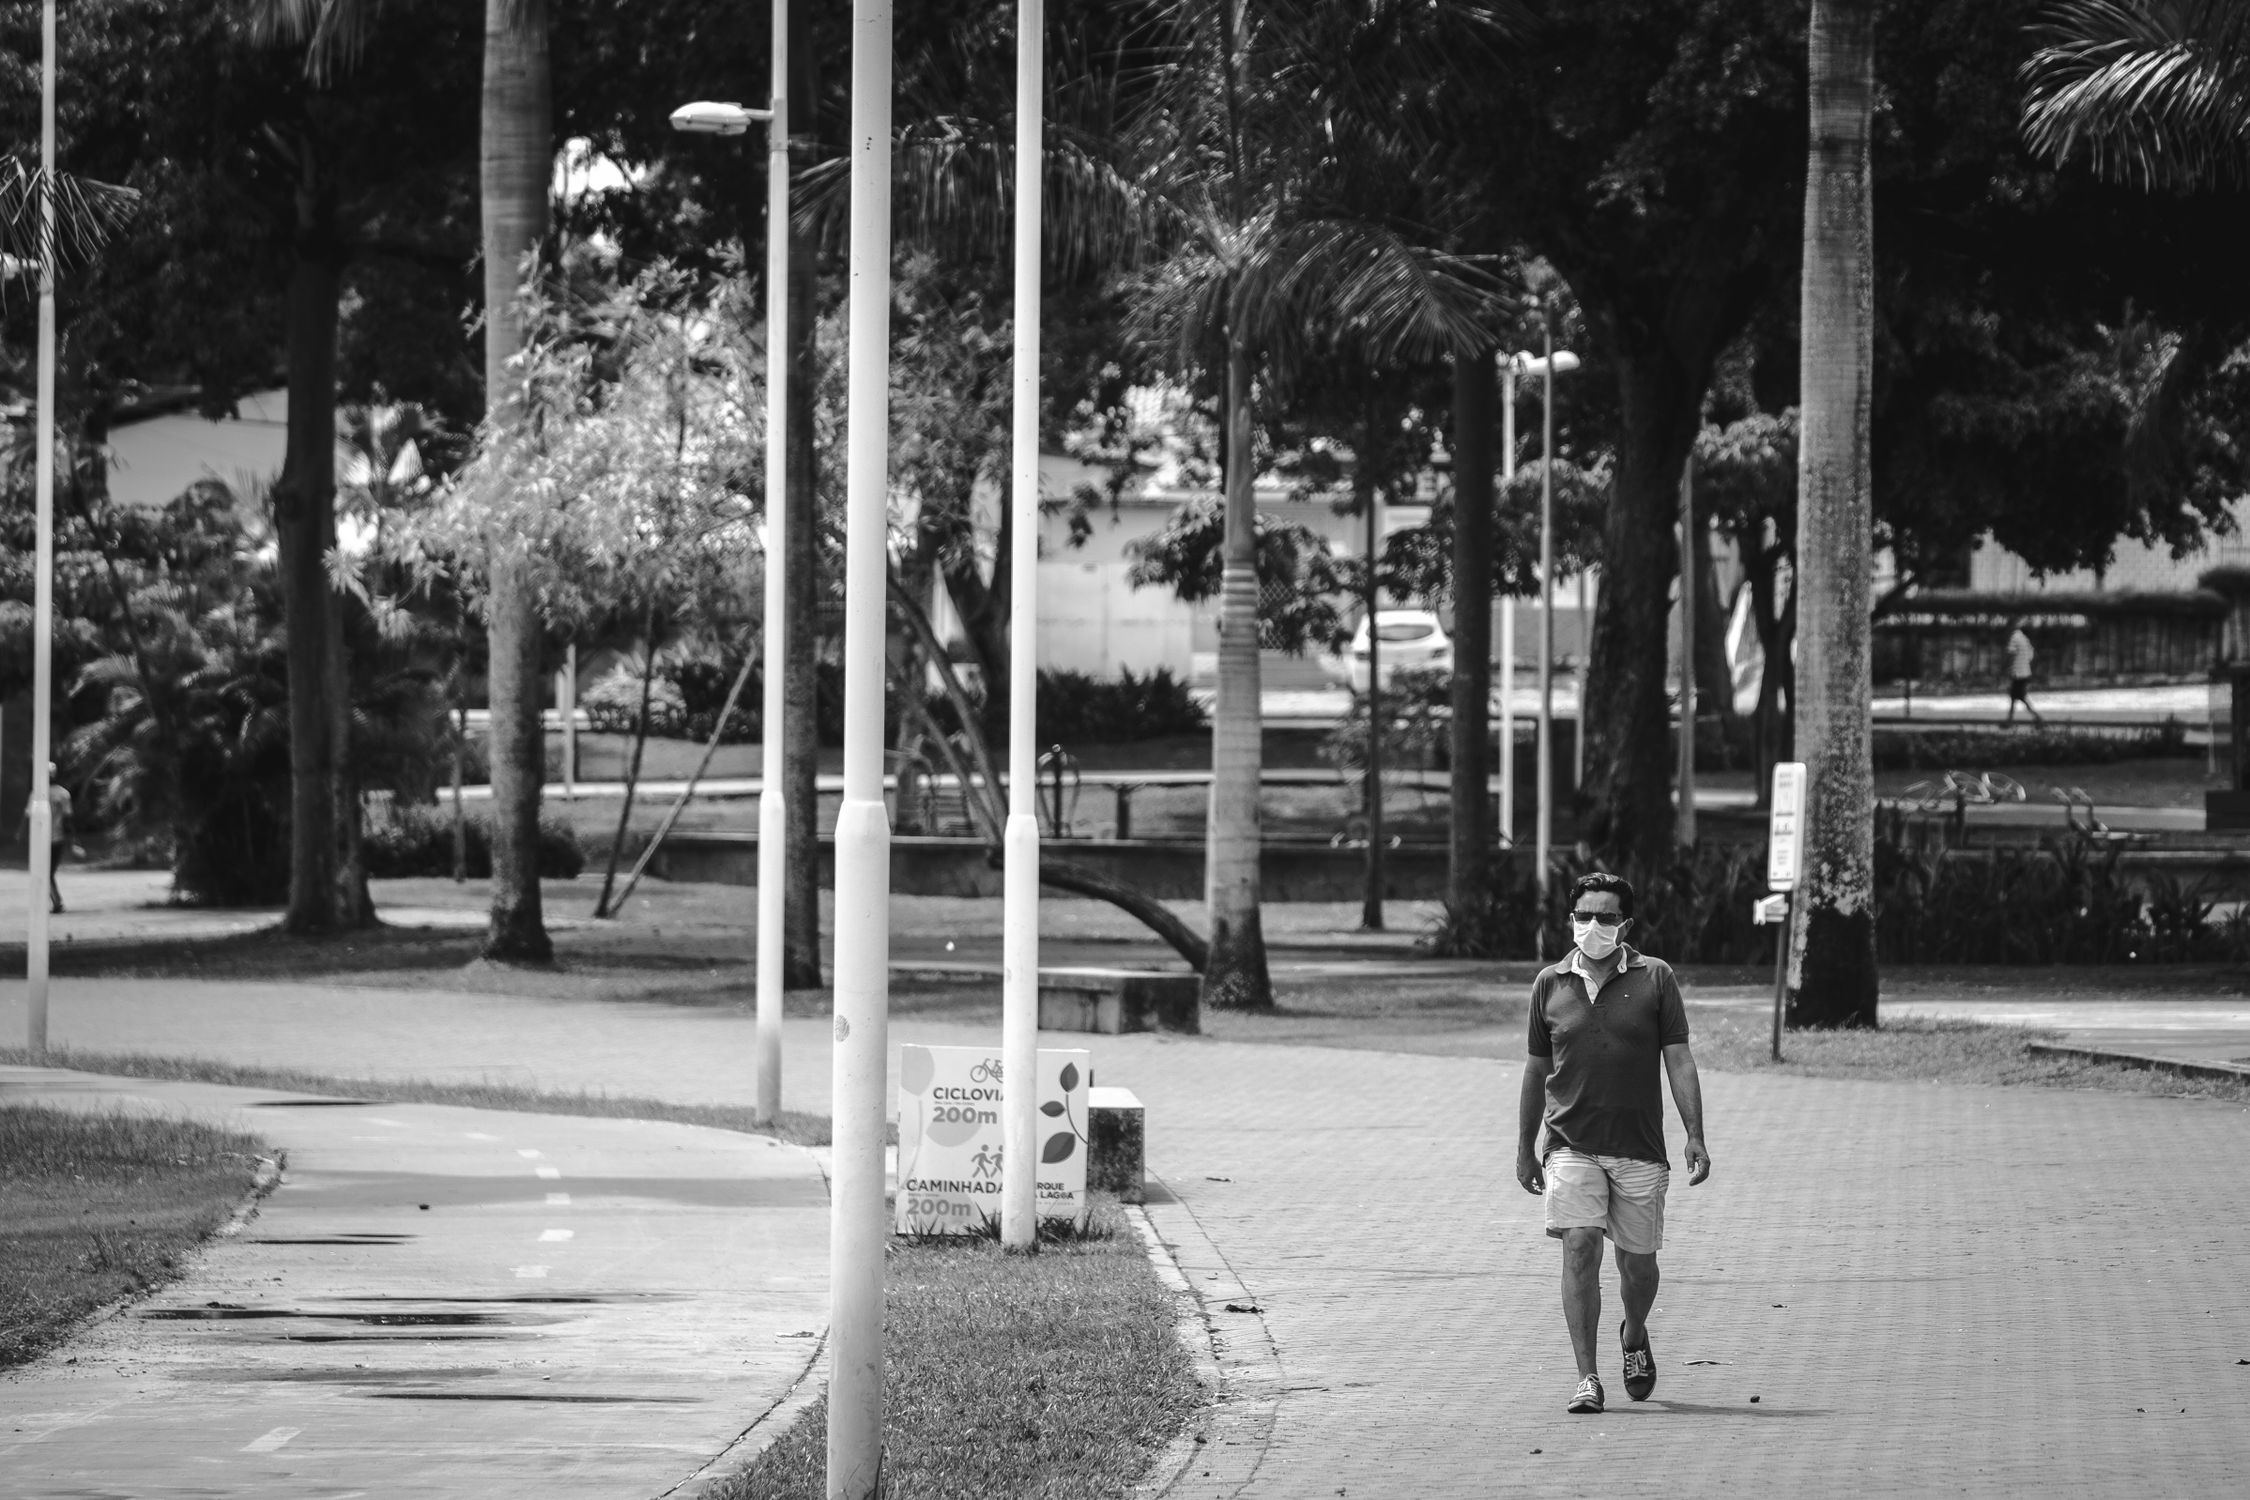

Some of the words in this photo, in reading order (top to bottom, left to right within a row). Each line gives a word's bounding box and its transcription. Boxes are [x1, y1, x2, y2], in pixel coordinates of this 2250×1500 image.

[933, 1087, 1004, 1101] CICLOVI
[932, 1106, 997, 1124] 200m
[1036, 1182, 1065, 1191] RQUE
[1040, 1191, 1074, 1200] LAGOA
[907, 1198, 971, 1216] 200m
